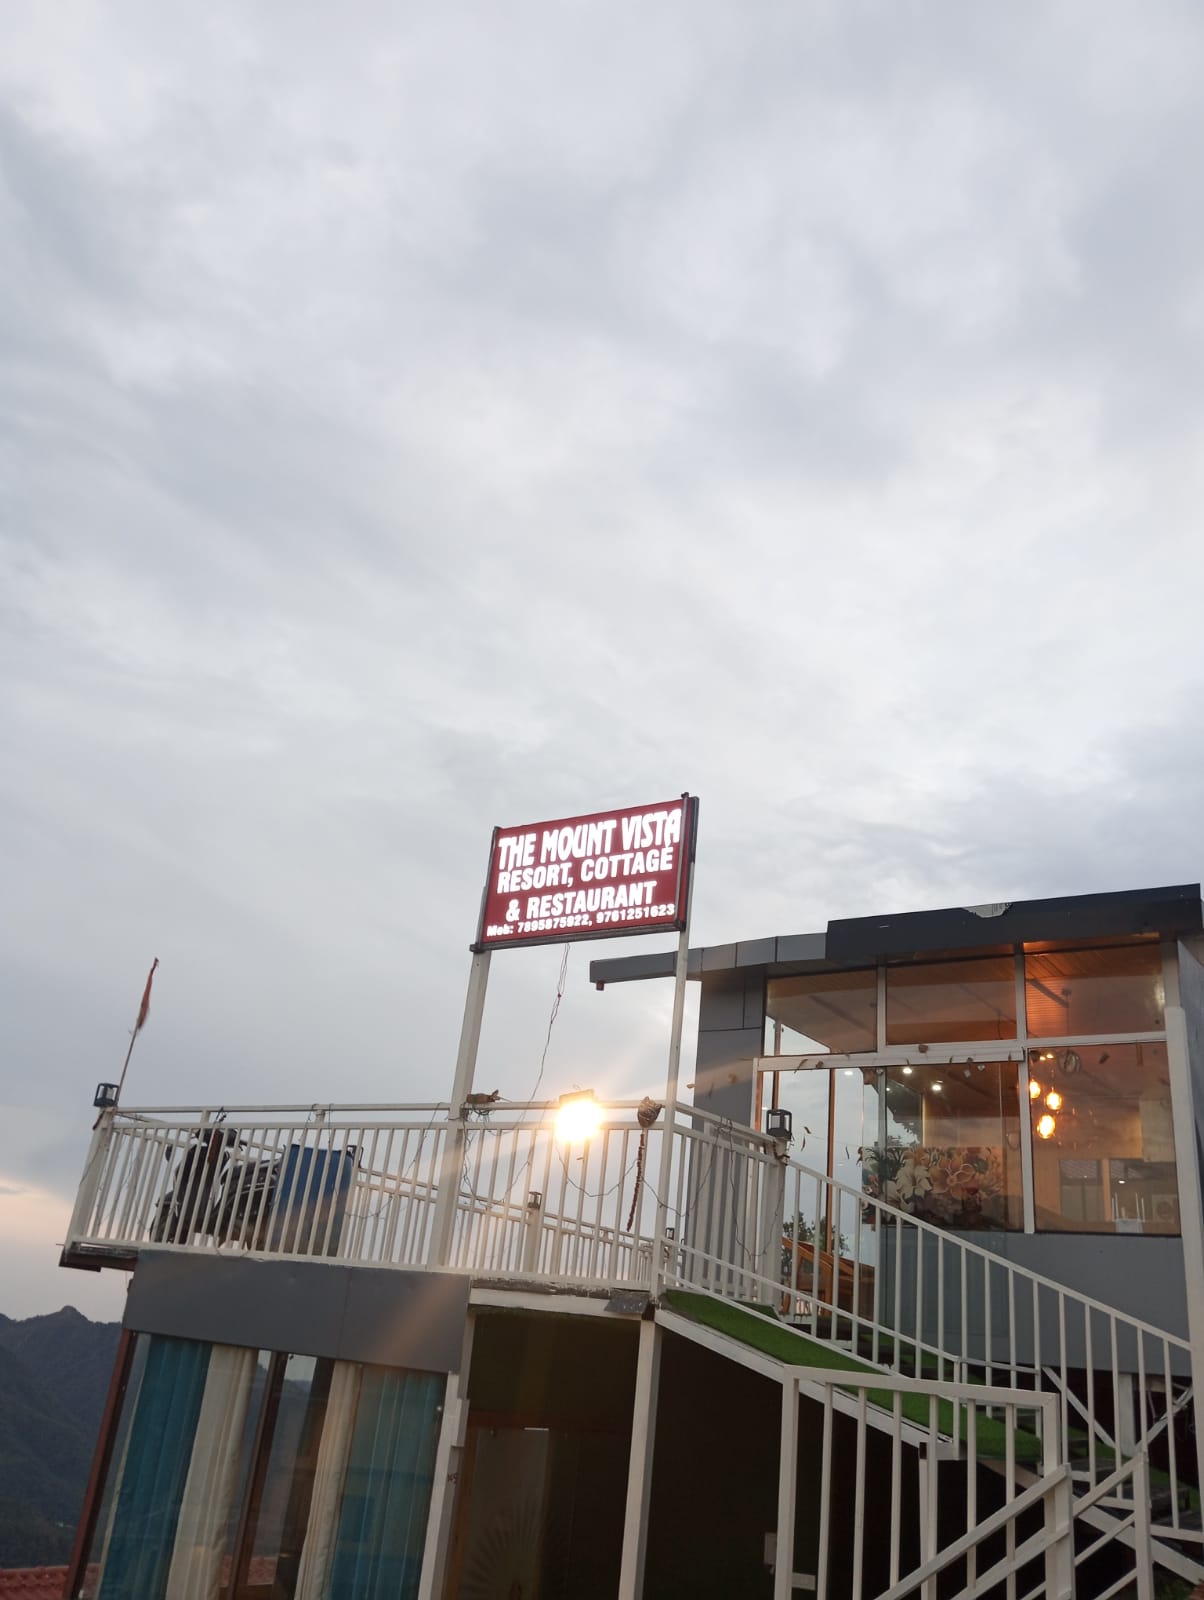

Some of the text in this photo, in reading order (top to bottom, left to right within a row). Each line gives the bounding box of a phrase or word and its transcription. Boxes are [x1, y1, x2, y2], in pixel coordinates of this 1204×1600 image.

[499, 809, 682, 871] THE MOUNT VISTA
[497, 847, 674, 894] RESORT, COTTAGE
[506, 881, 657, 922] & RESTAURANT
